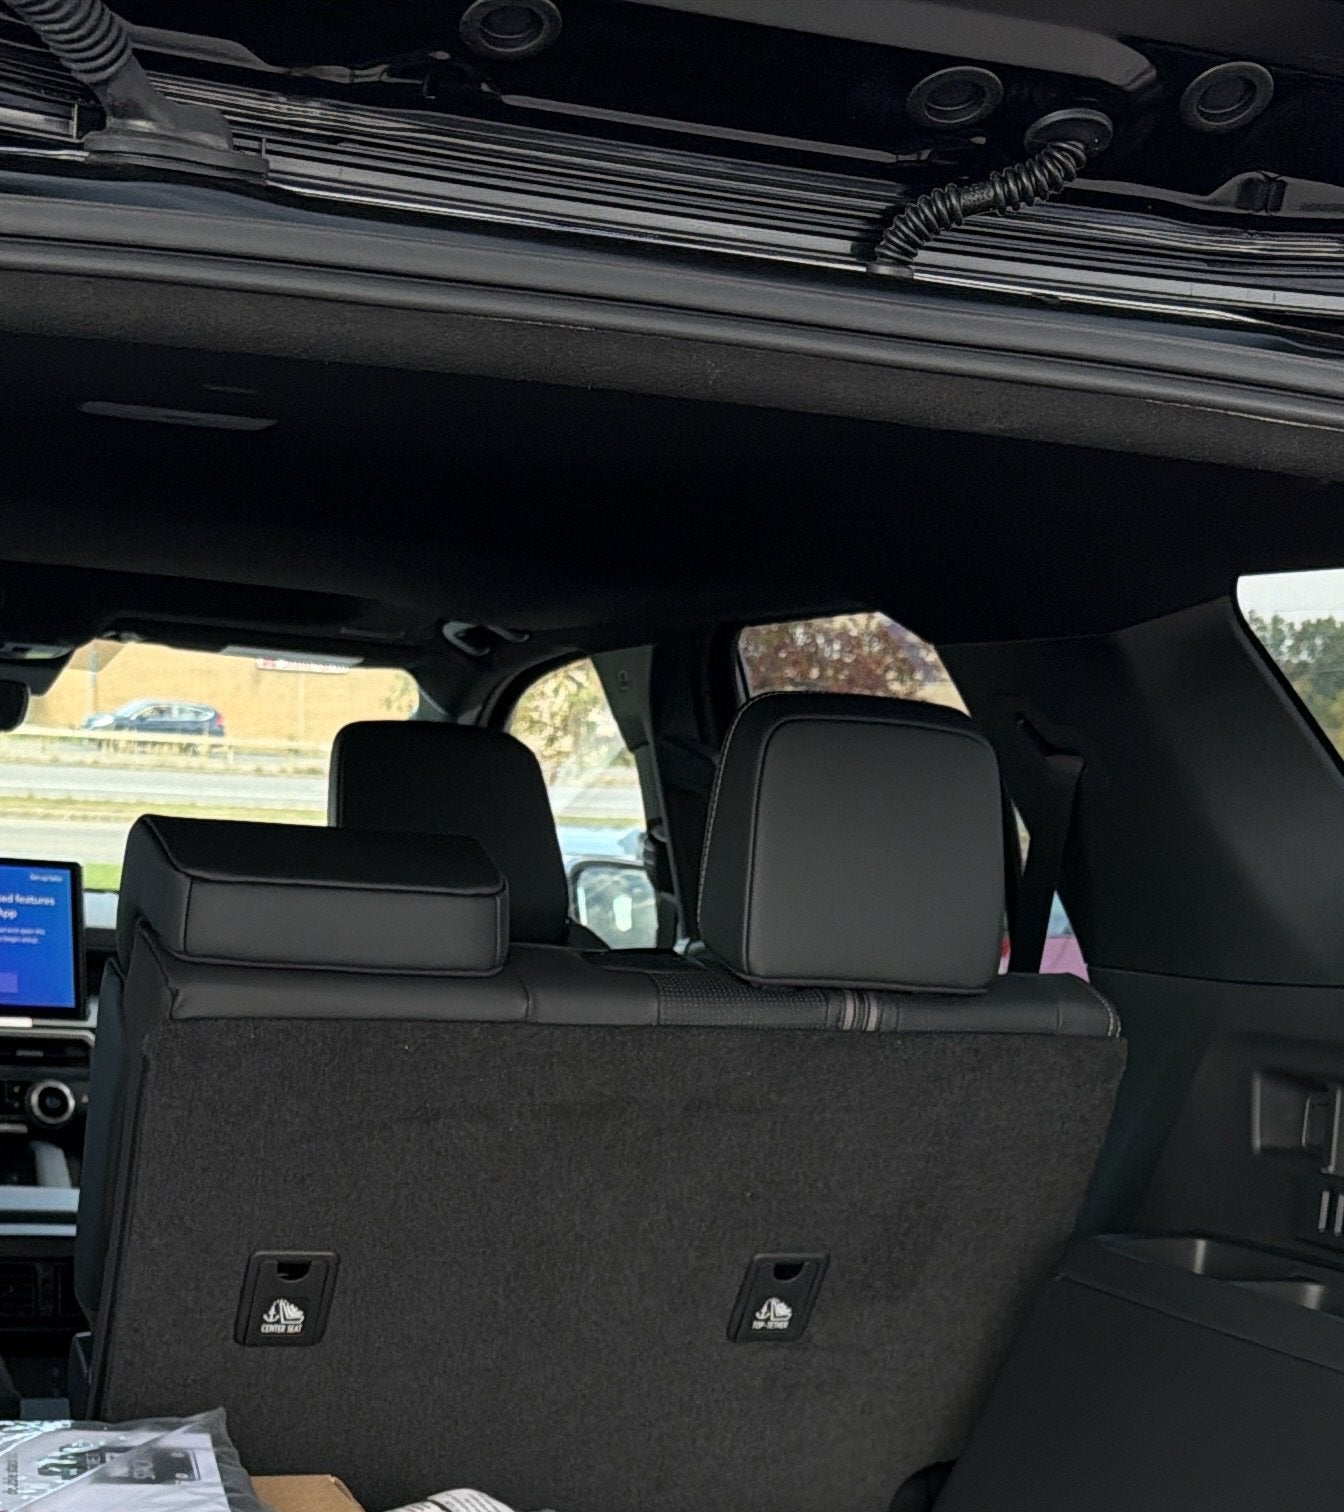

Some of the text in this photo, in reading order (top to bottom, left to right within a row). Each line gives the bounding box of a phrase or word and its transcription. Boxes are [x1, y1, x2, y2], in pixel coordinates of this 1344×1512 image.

[15, 892, 55, 906] features
[260, 1323, 304, 1334] CENTER SEAT
